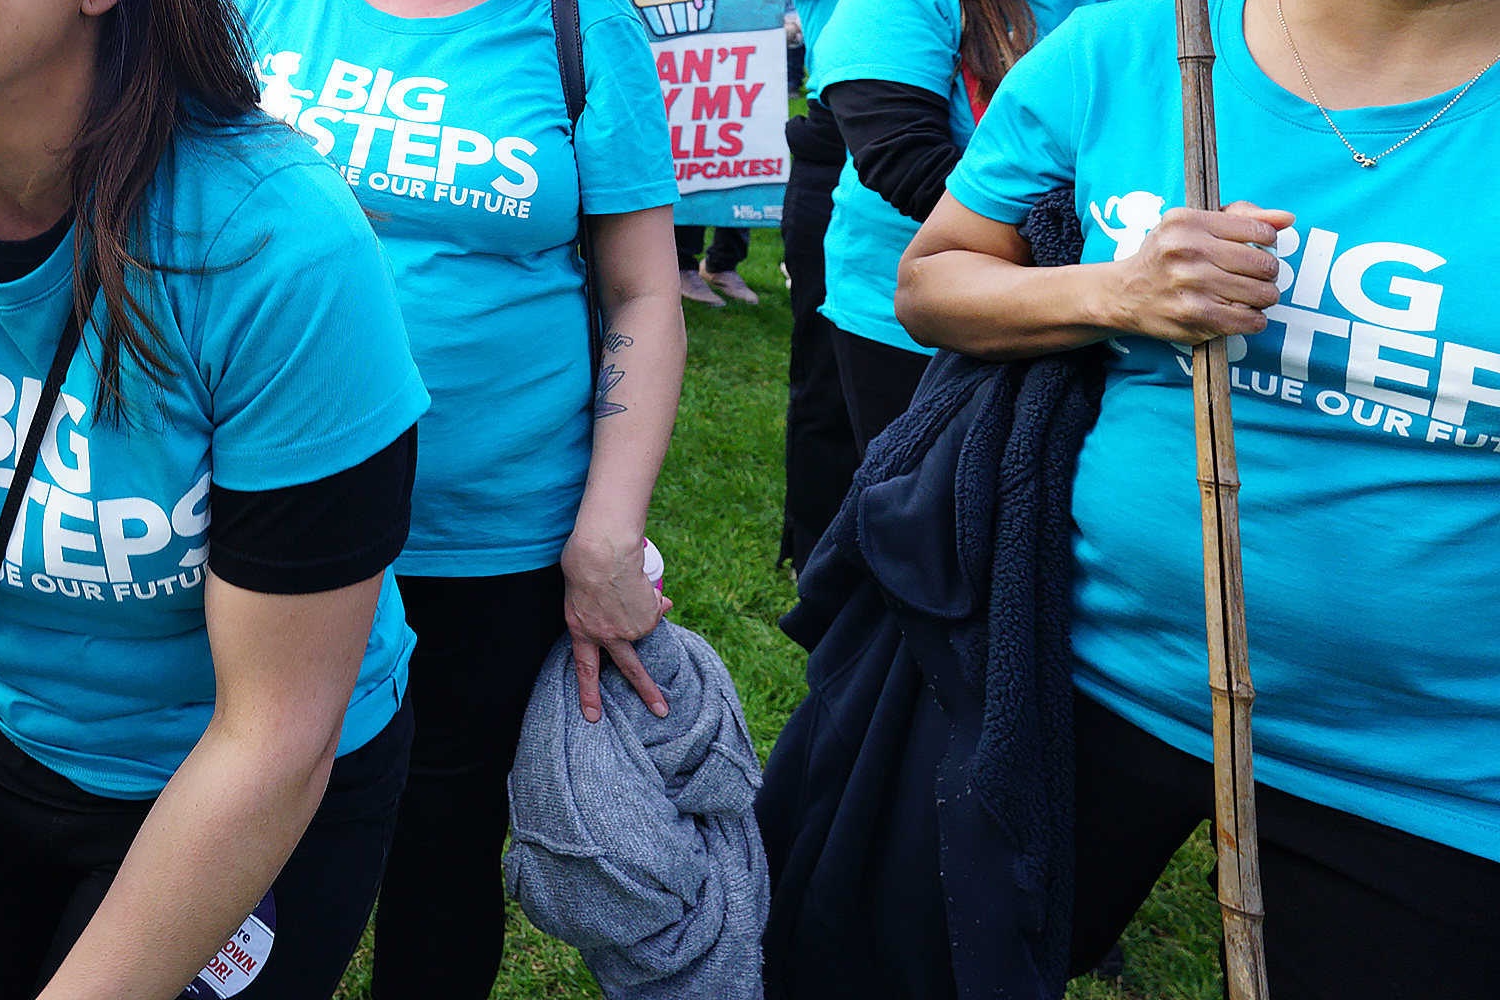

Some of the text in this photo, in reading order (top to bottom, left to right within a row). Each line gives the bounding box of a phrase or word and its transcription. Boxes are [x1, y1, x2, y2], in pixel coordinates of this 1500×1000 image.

[655, 45, 756, 85] AN'T
[316, 58, 449, 123] BIG
[691, 82, 765, 121] MY
[297, 105, 539, 200] STEPS
[670, 121, 744, 160] LLS
[673, 157, 783, 181] UPCAKES!
[368, 171, 427, 200] OUR
[433, 183, 532, 220] FUTURE
[1176, 354, 1305, 405] VLUE
[1315, 389, 1412, 439] OUR
[31, 571, 105, 603] OUR
[115, 563, 209, 603] FUTU
